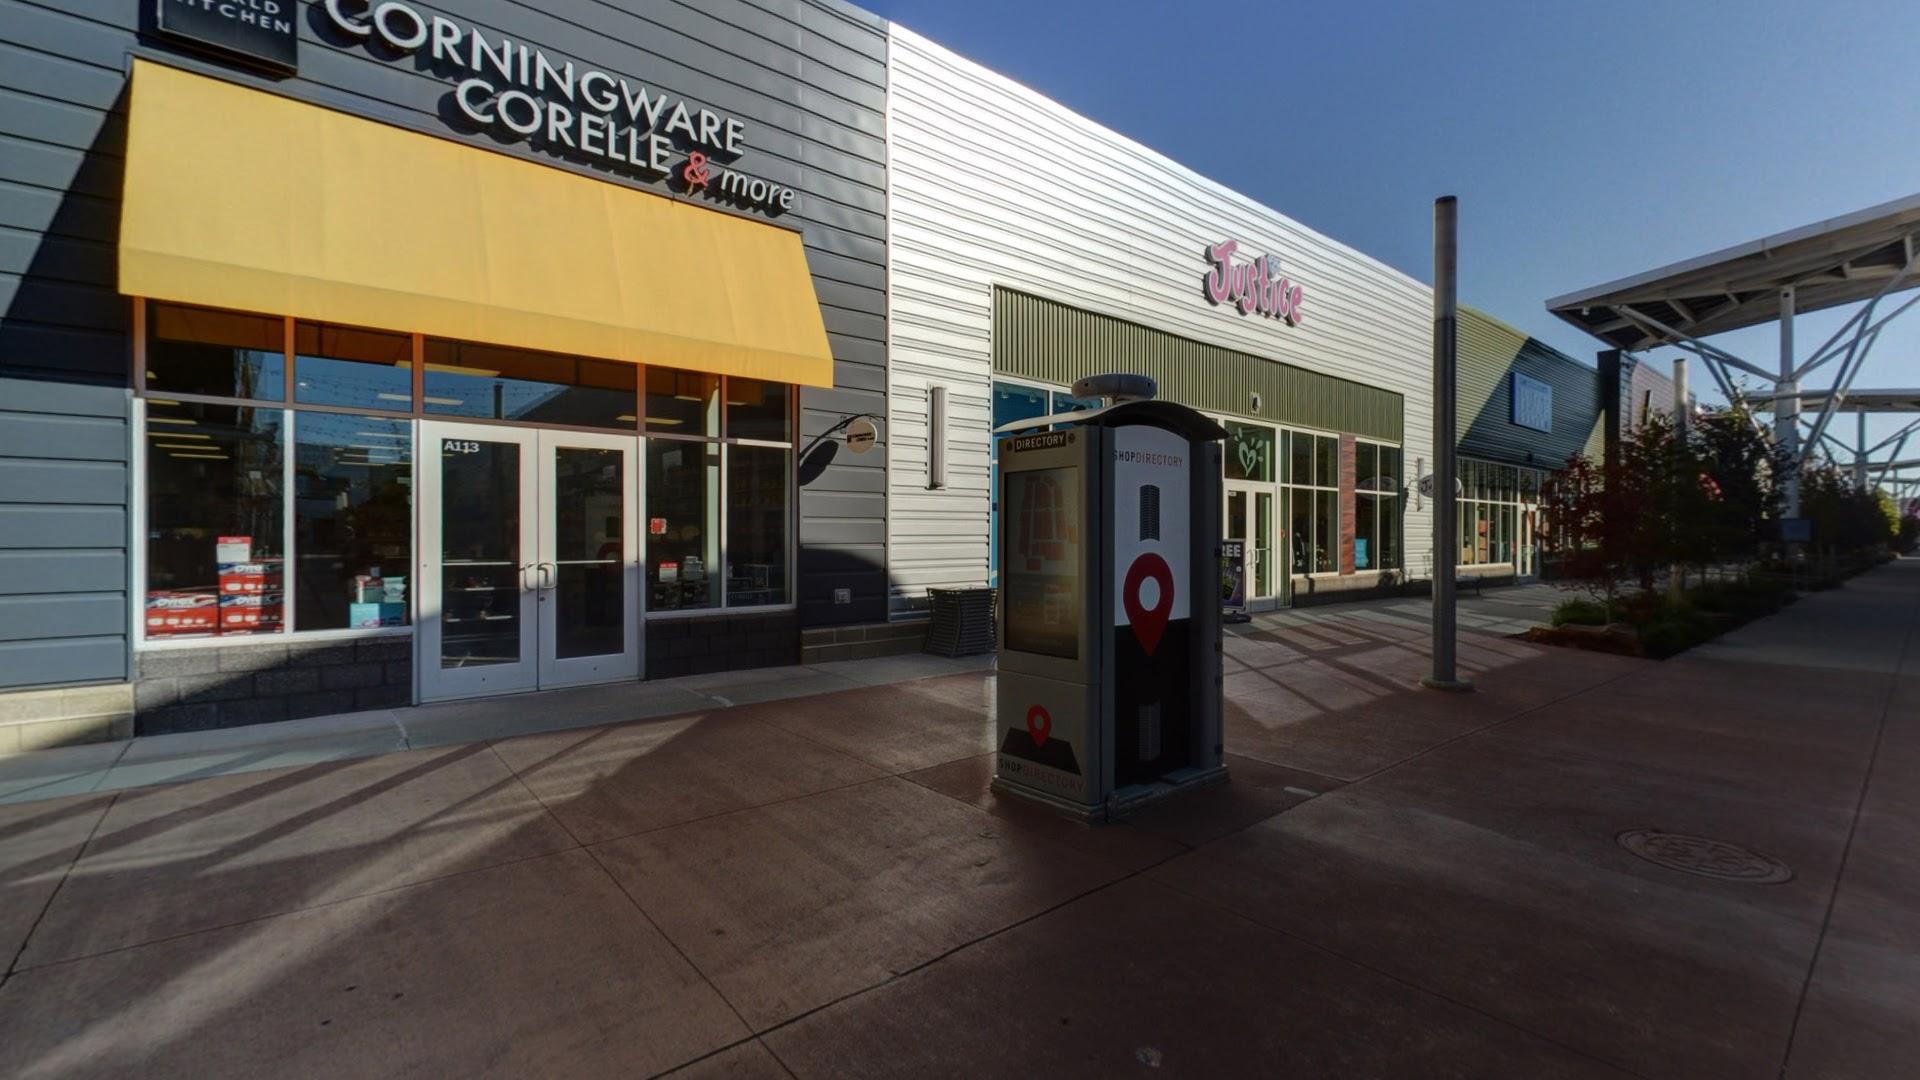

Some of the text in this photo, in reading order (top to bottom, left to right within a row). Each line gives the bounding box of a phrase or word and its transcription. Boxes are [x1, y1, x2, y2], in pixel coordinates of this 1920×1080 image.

[324, 0, 744, 156] CORNINGWARE
[455, 80, 795, 211] CORELLE & more
[1207, 239, 1303, 327] Justice
[444, 440, 480, 453] A113
[1016, 434, 1064, 449] DIRECTORY
